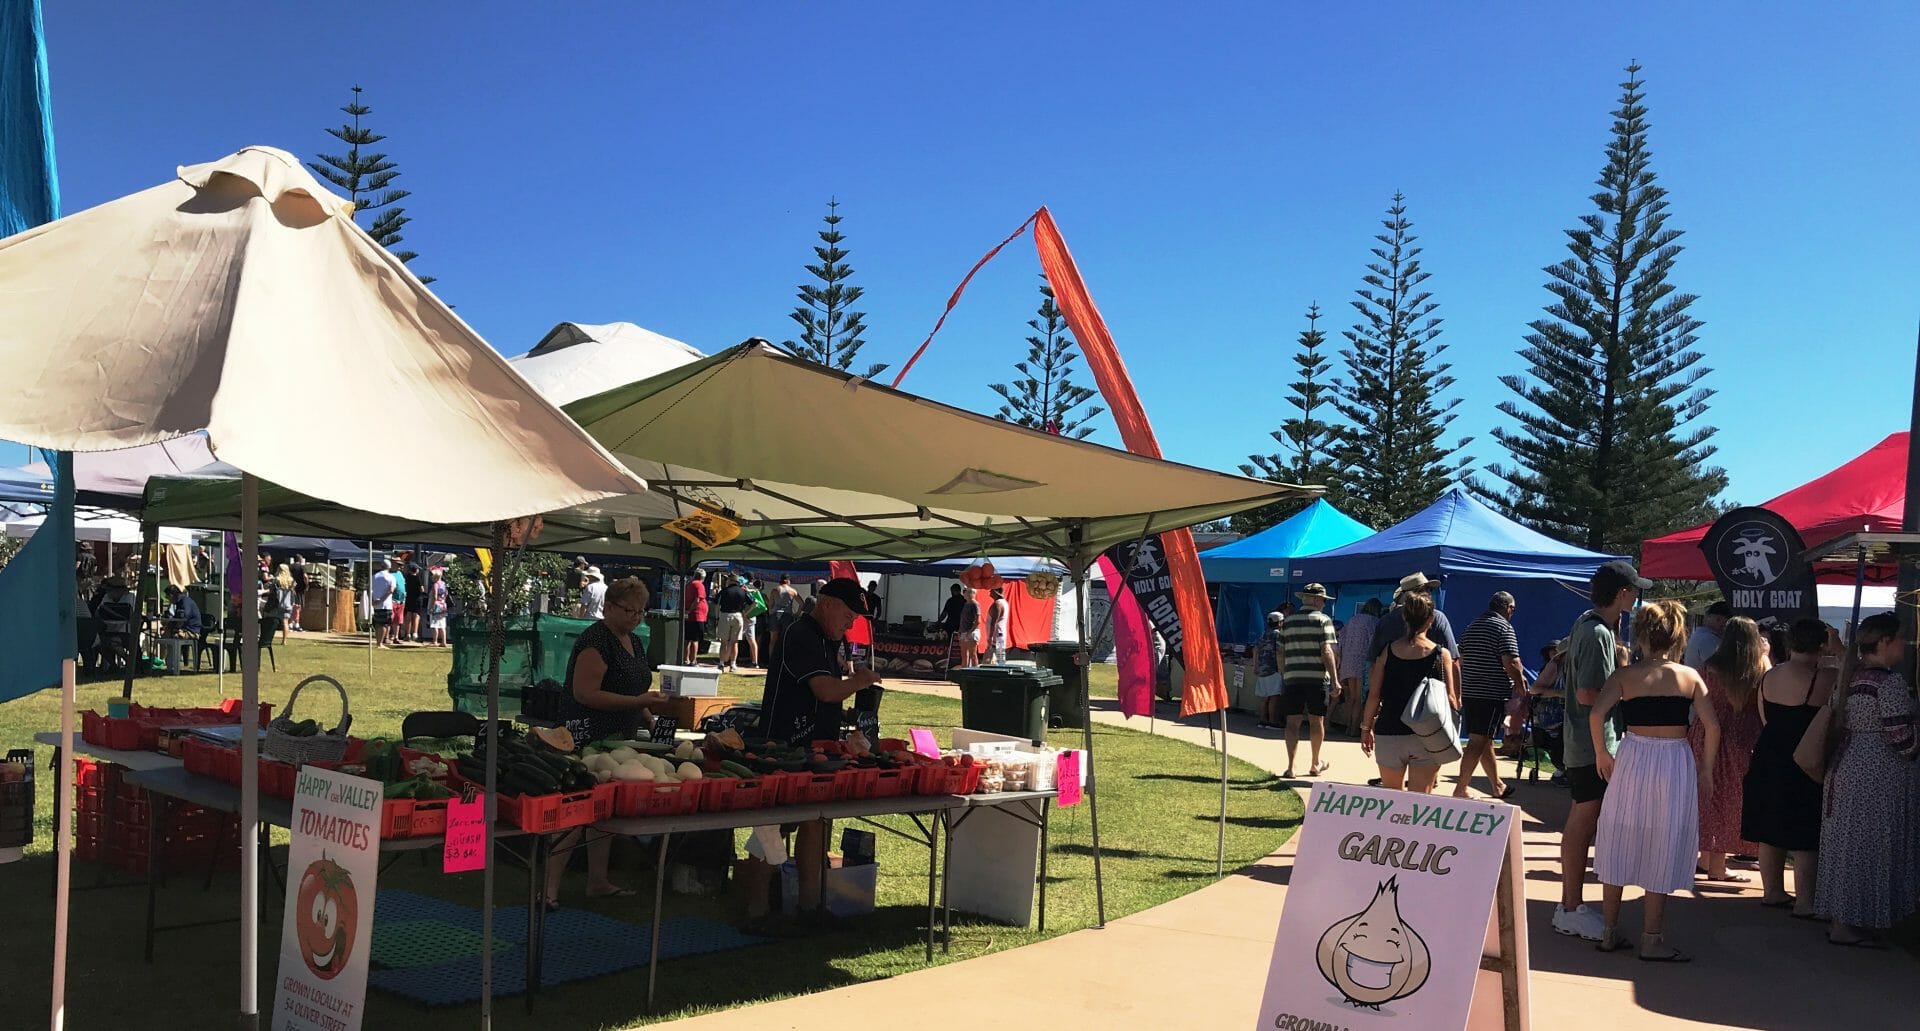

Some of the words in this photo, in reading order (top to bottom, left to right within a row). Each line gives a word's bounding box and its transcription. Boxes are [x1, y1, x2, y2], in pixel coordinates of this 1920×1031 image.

[1133, 578, 1156, 595] HOLY
[1158, 575, 1171, 590] GO
[1732, 589, 1764, 609] HOLY
[1769, 590, 1802, 609] GOAT
[297, 773, 332, 801] HAPPY
[340, 783, 379, 812] VALLEY
[300, 808, 370, 851] TOMATOES
[1313, 791, 1394, 820] HAPPY
[1410, 803, 1505, 836] VALLEY
[1337, 831, 1459, 875] GARLIC
[283, 976, 311, 999] GROWN
[310, 988, 343, 1014] LOCALLY
[341, 1003, 354, 1018] AT
[294, 1002, 321, 1025] OLIVER
